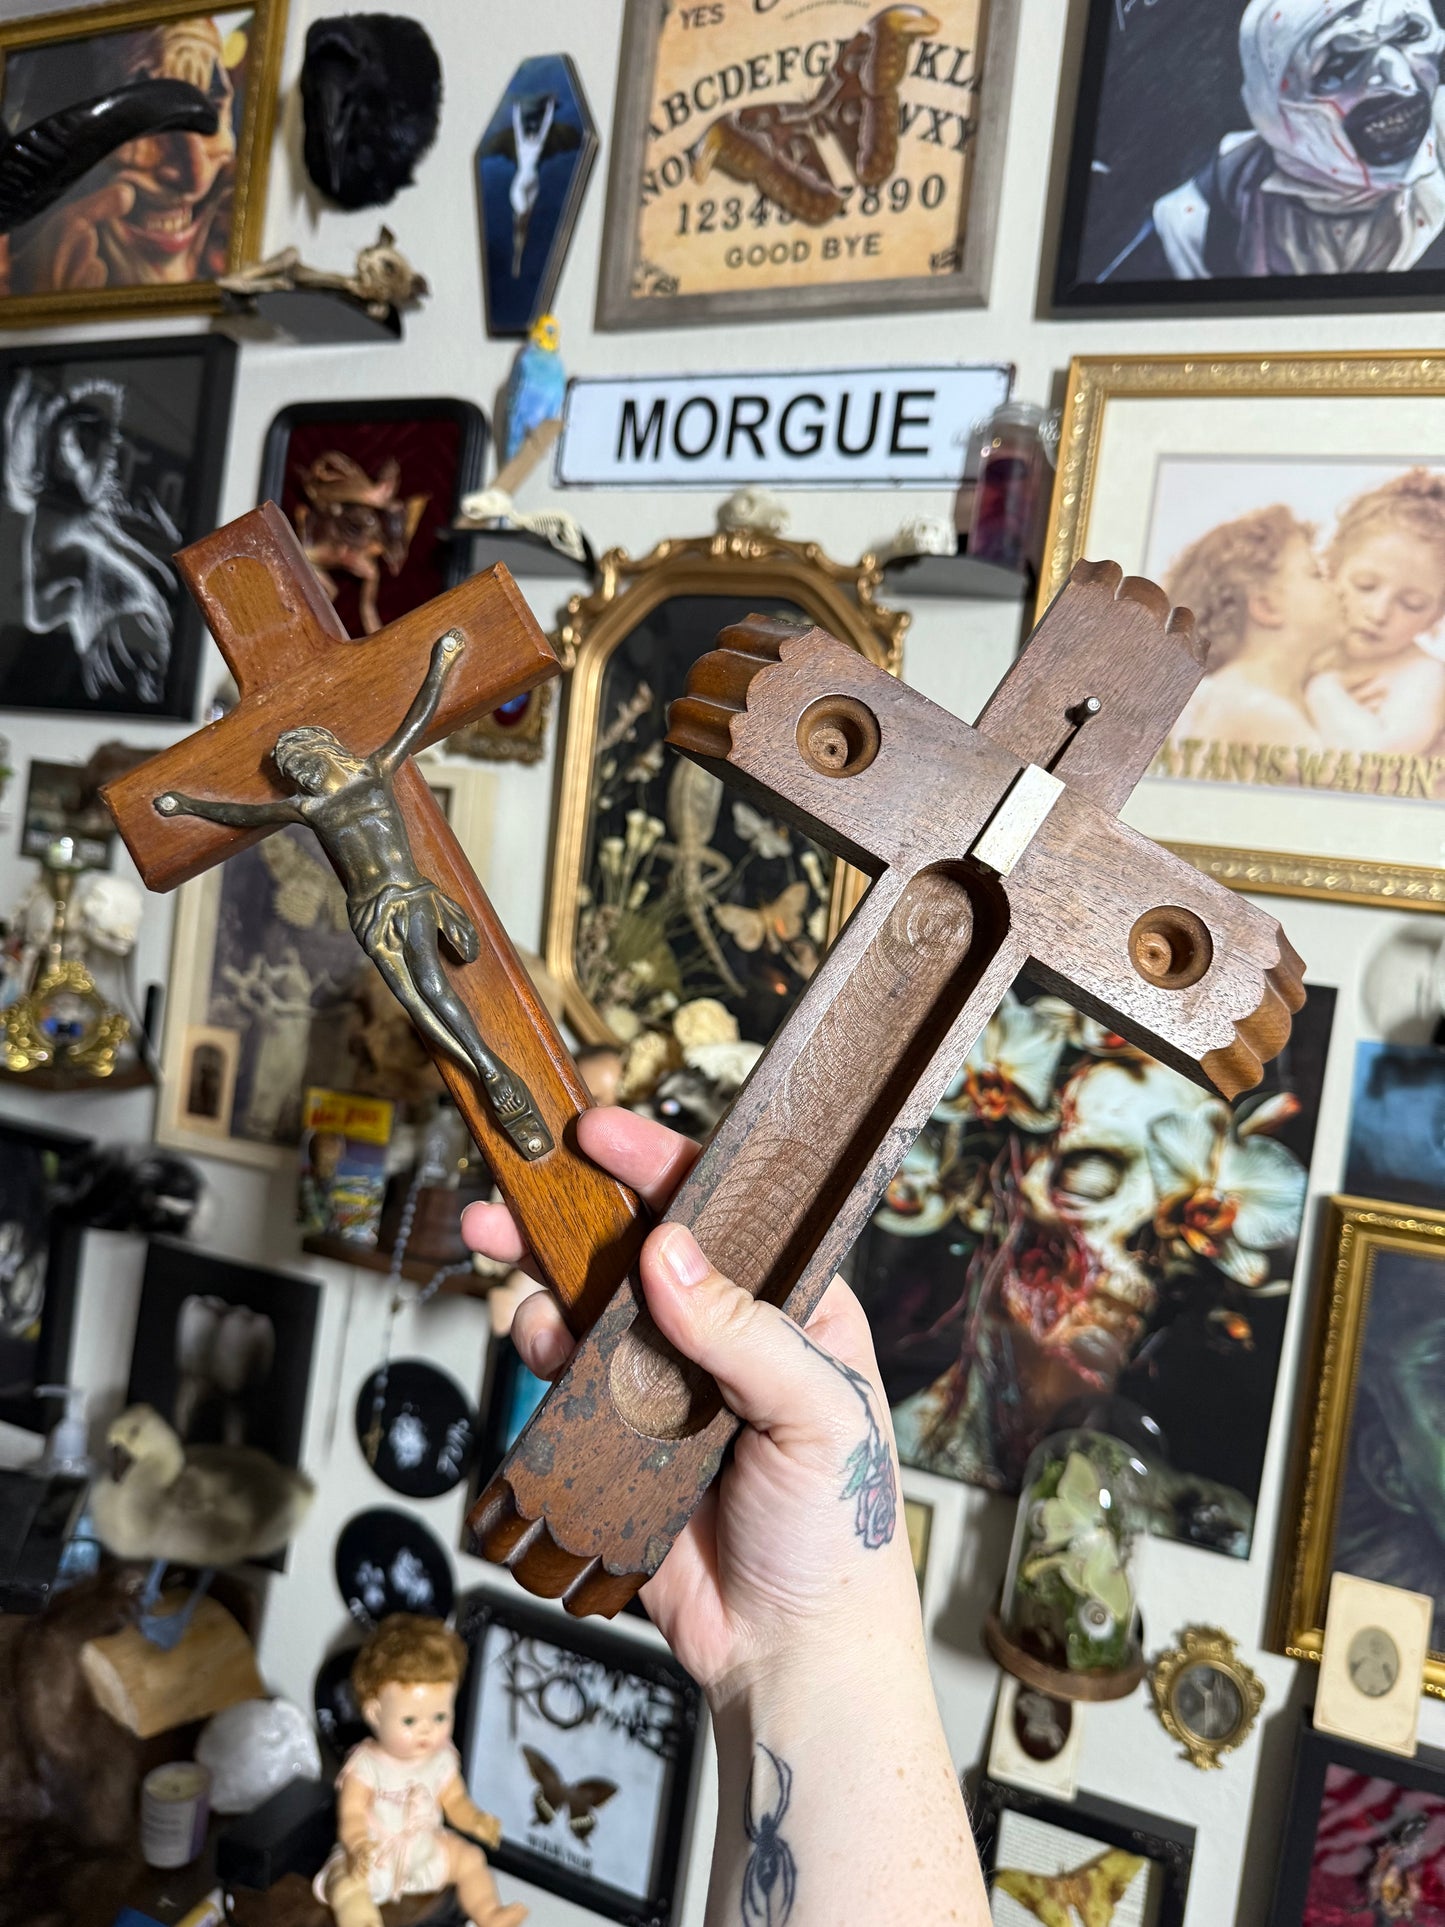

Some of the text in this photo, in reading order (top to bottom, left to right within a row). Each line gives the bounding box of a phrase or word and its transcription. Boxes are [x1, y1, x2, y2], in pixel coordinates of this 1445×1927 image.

[680, 5, 725, 31] YES
[725, 233, 882, 269] GOOD BYE
[615, 389, 937, 463] MORGUE
[1149, 738, 1254, 783] ATAN
